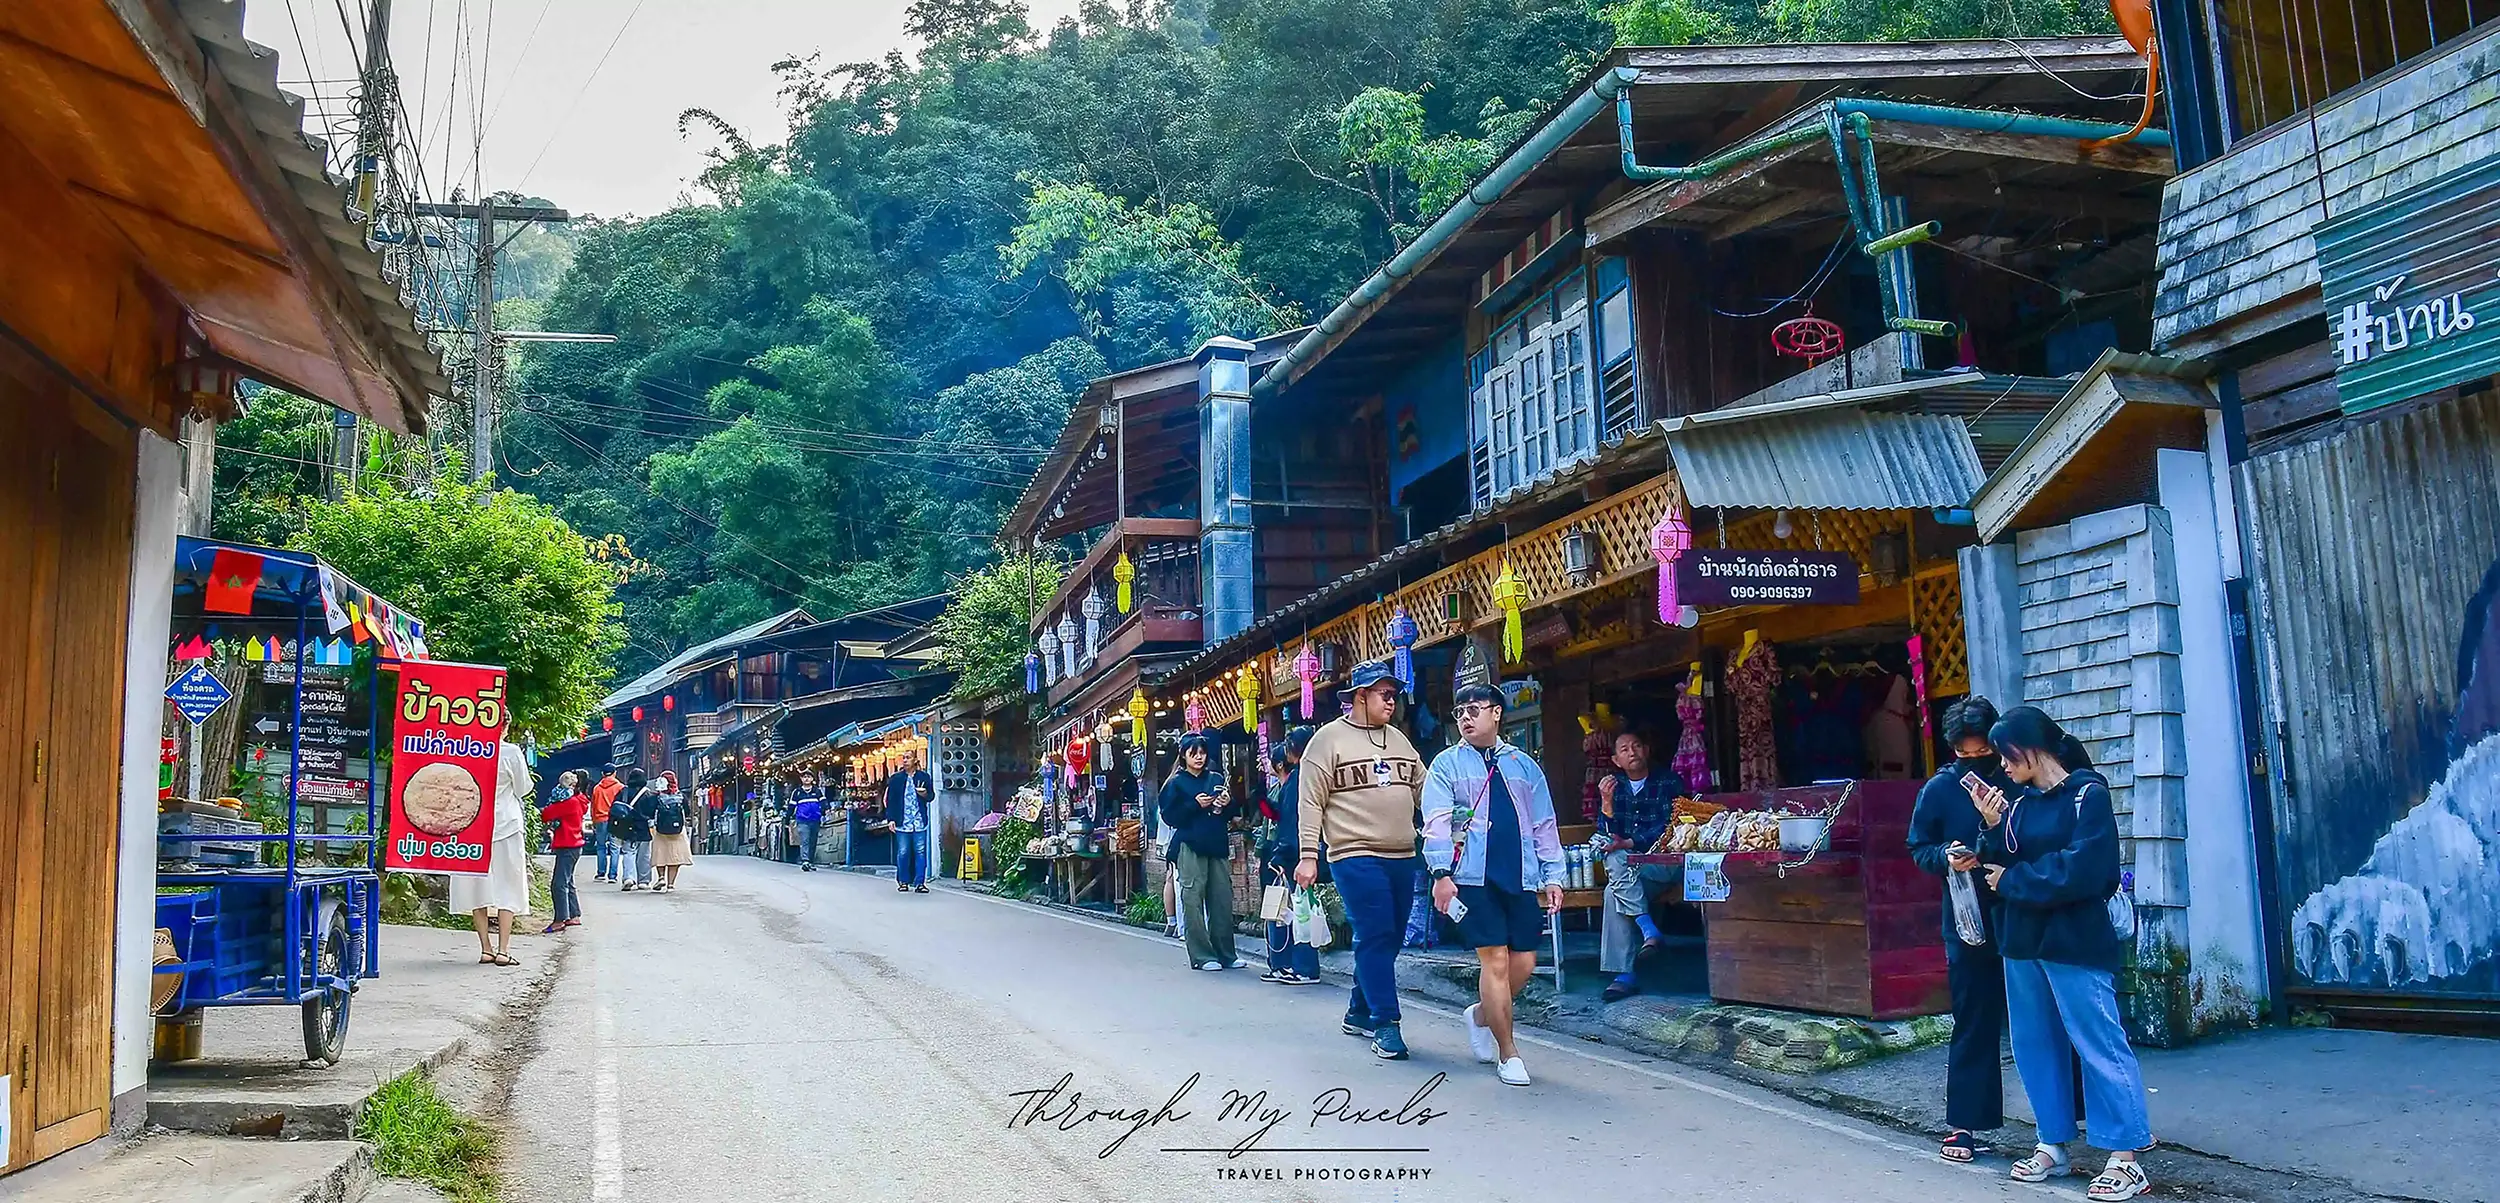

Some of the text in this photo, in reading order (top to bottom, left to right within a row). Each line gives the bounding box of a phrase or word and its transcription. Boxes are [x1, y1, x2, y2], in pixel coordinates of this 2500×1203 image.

[2337, 275, 2475, 365] #บ้าน
[1699, 555, 1837, 578] บ้านพักติดลำธาร
[1730, 586, 1812, 599] 090-9096397
[182, 680, 214, 693] ที่จอดรถ
[308, 690, 345, 703] คาเฟ่ลับ
[402, 676, 503, 728] ข้าวจี่
[403, 729, 496, 760] แม่กำปอง
[398, 833, 484, 861] นุ่ม อร่อย
